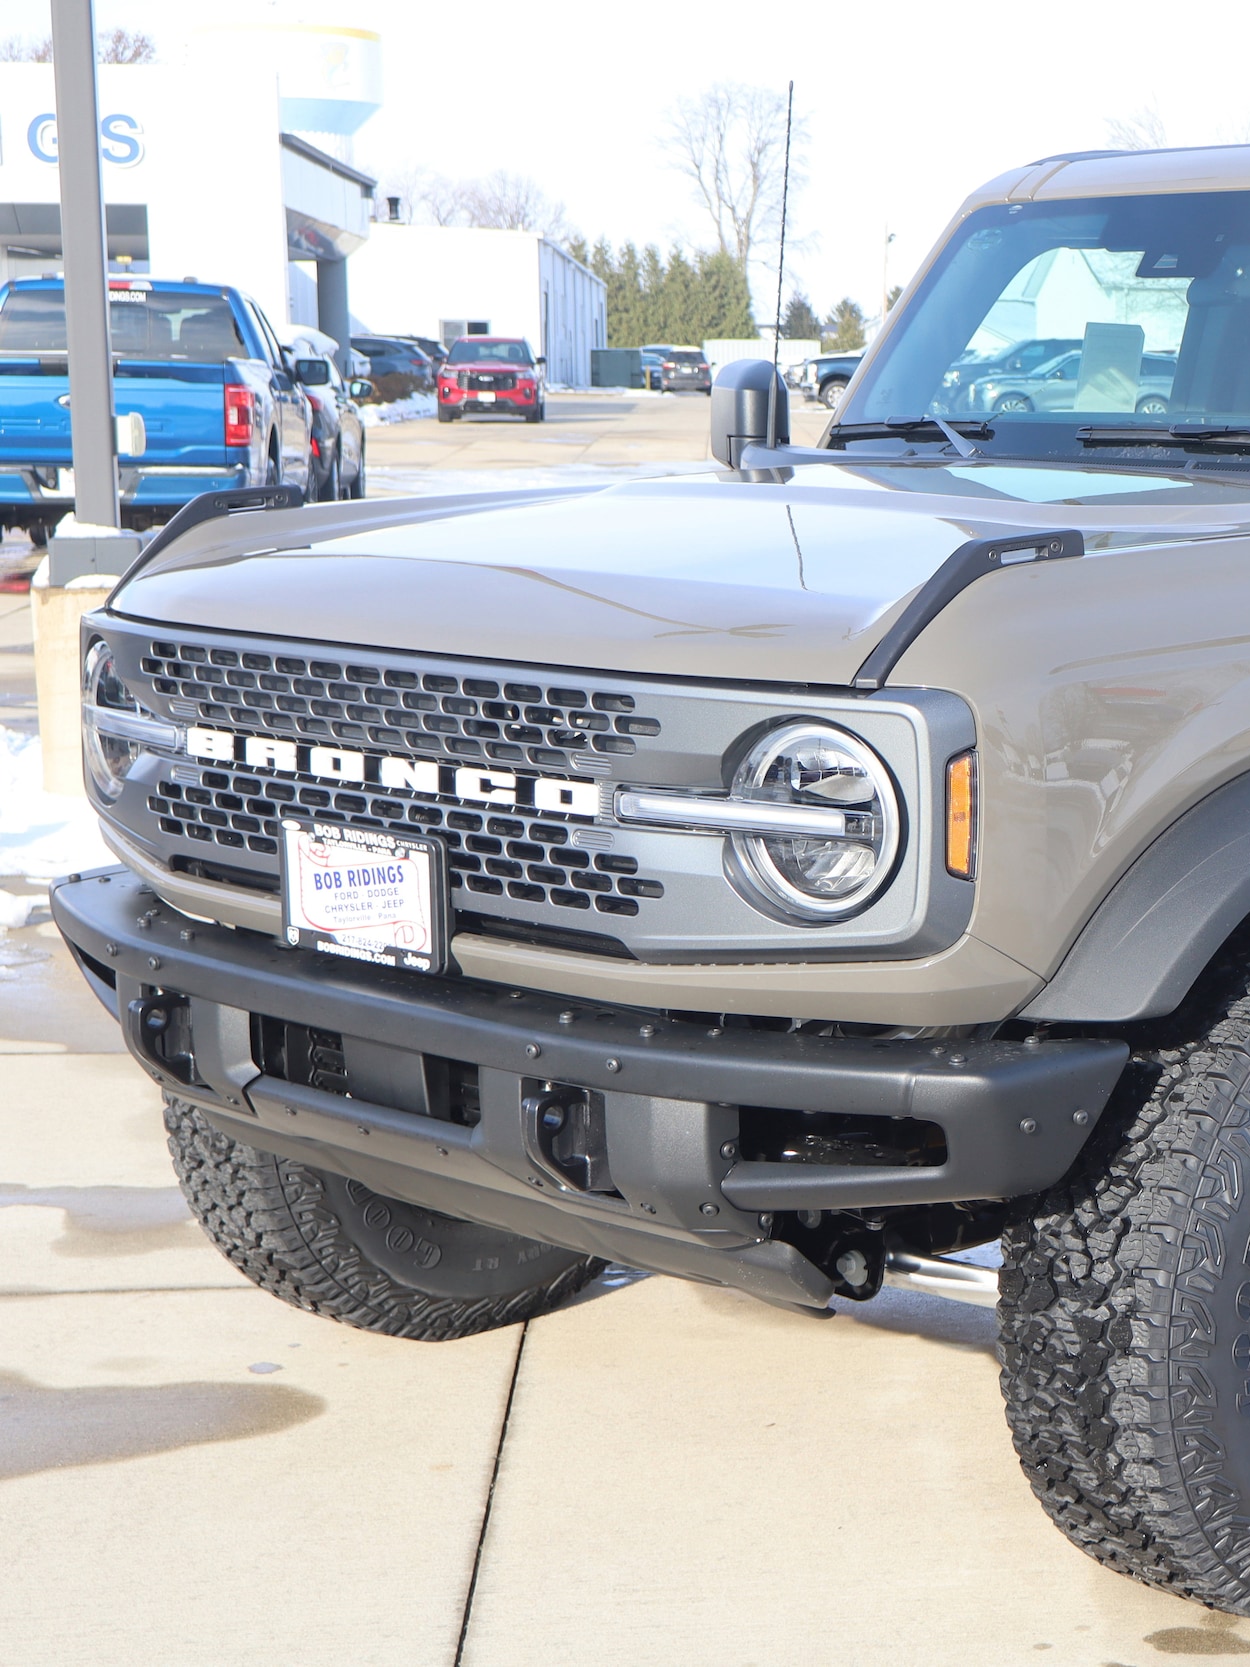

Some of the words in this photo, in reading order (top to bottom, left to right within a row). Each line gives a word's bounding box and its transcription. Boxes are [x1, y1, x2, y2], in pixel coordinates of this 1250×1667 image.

[186, 726, 600, 817] BRONCO
[313, 823, 341, 840] BOB
[343, 828, 396, 850] RIDINGS
[396, 840, 428, 852] CHRYSLER
[314, 871, 342, 890] BOB
[347, 865, 404, 887] RIDINGS
[334, 891, 359, 900] FORD
[367, 887, 399, 897] DODGE
[324, 902, 373, 913] CHRYSLER
[381, 899, 404, 909] JEEP
[333, 915, 371, 924] Taylorville
[317, 940, 396, 966] BOBRIDINGS.COM
[403, 952, 430, 971] Jeep
